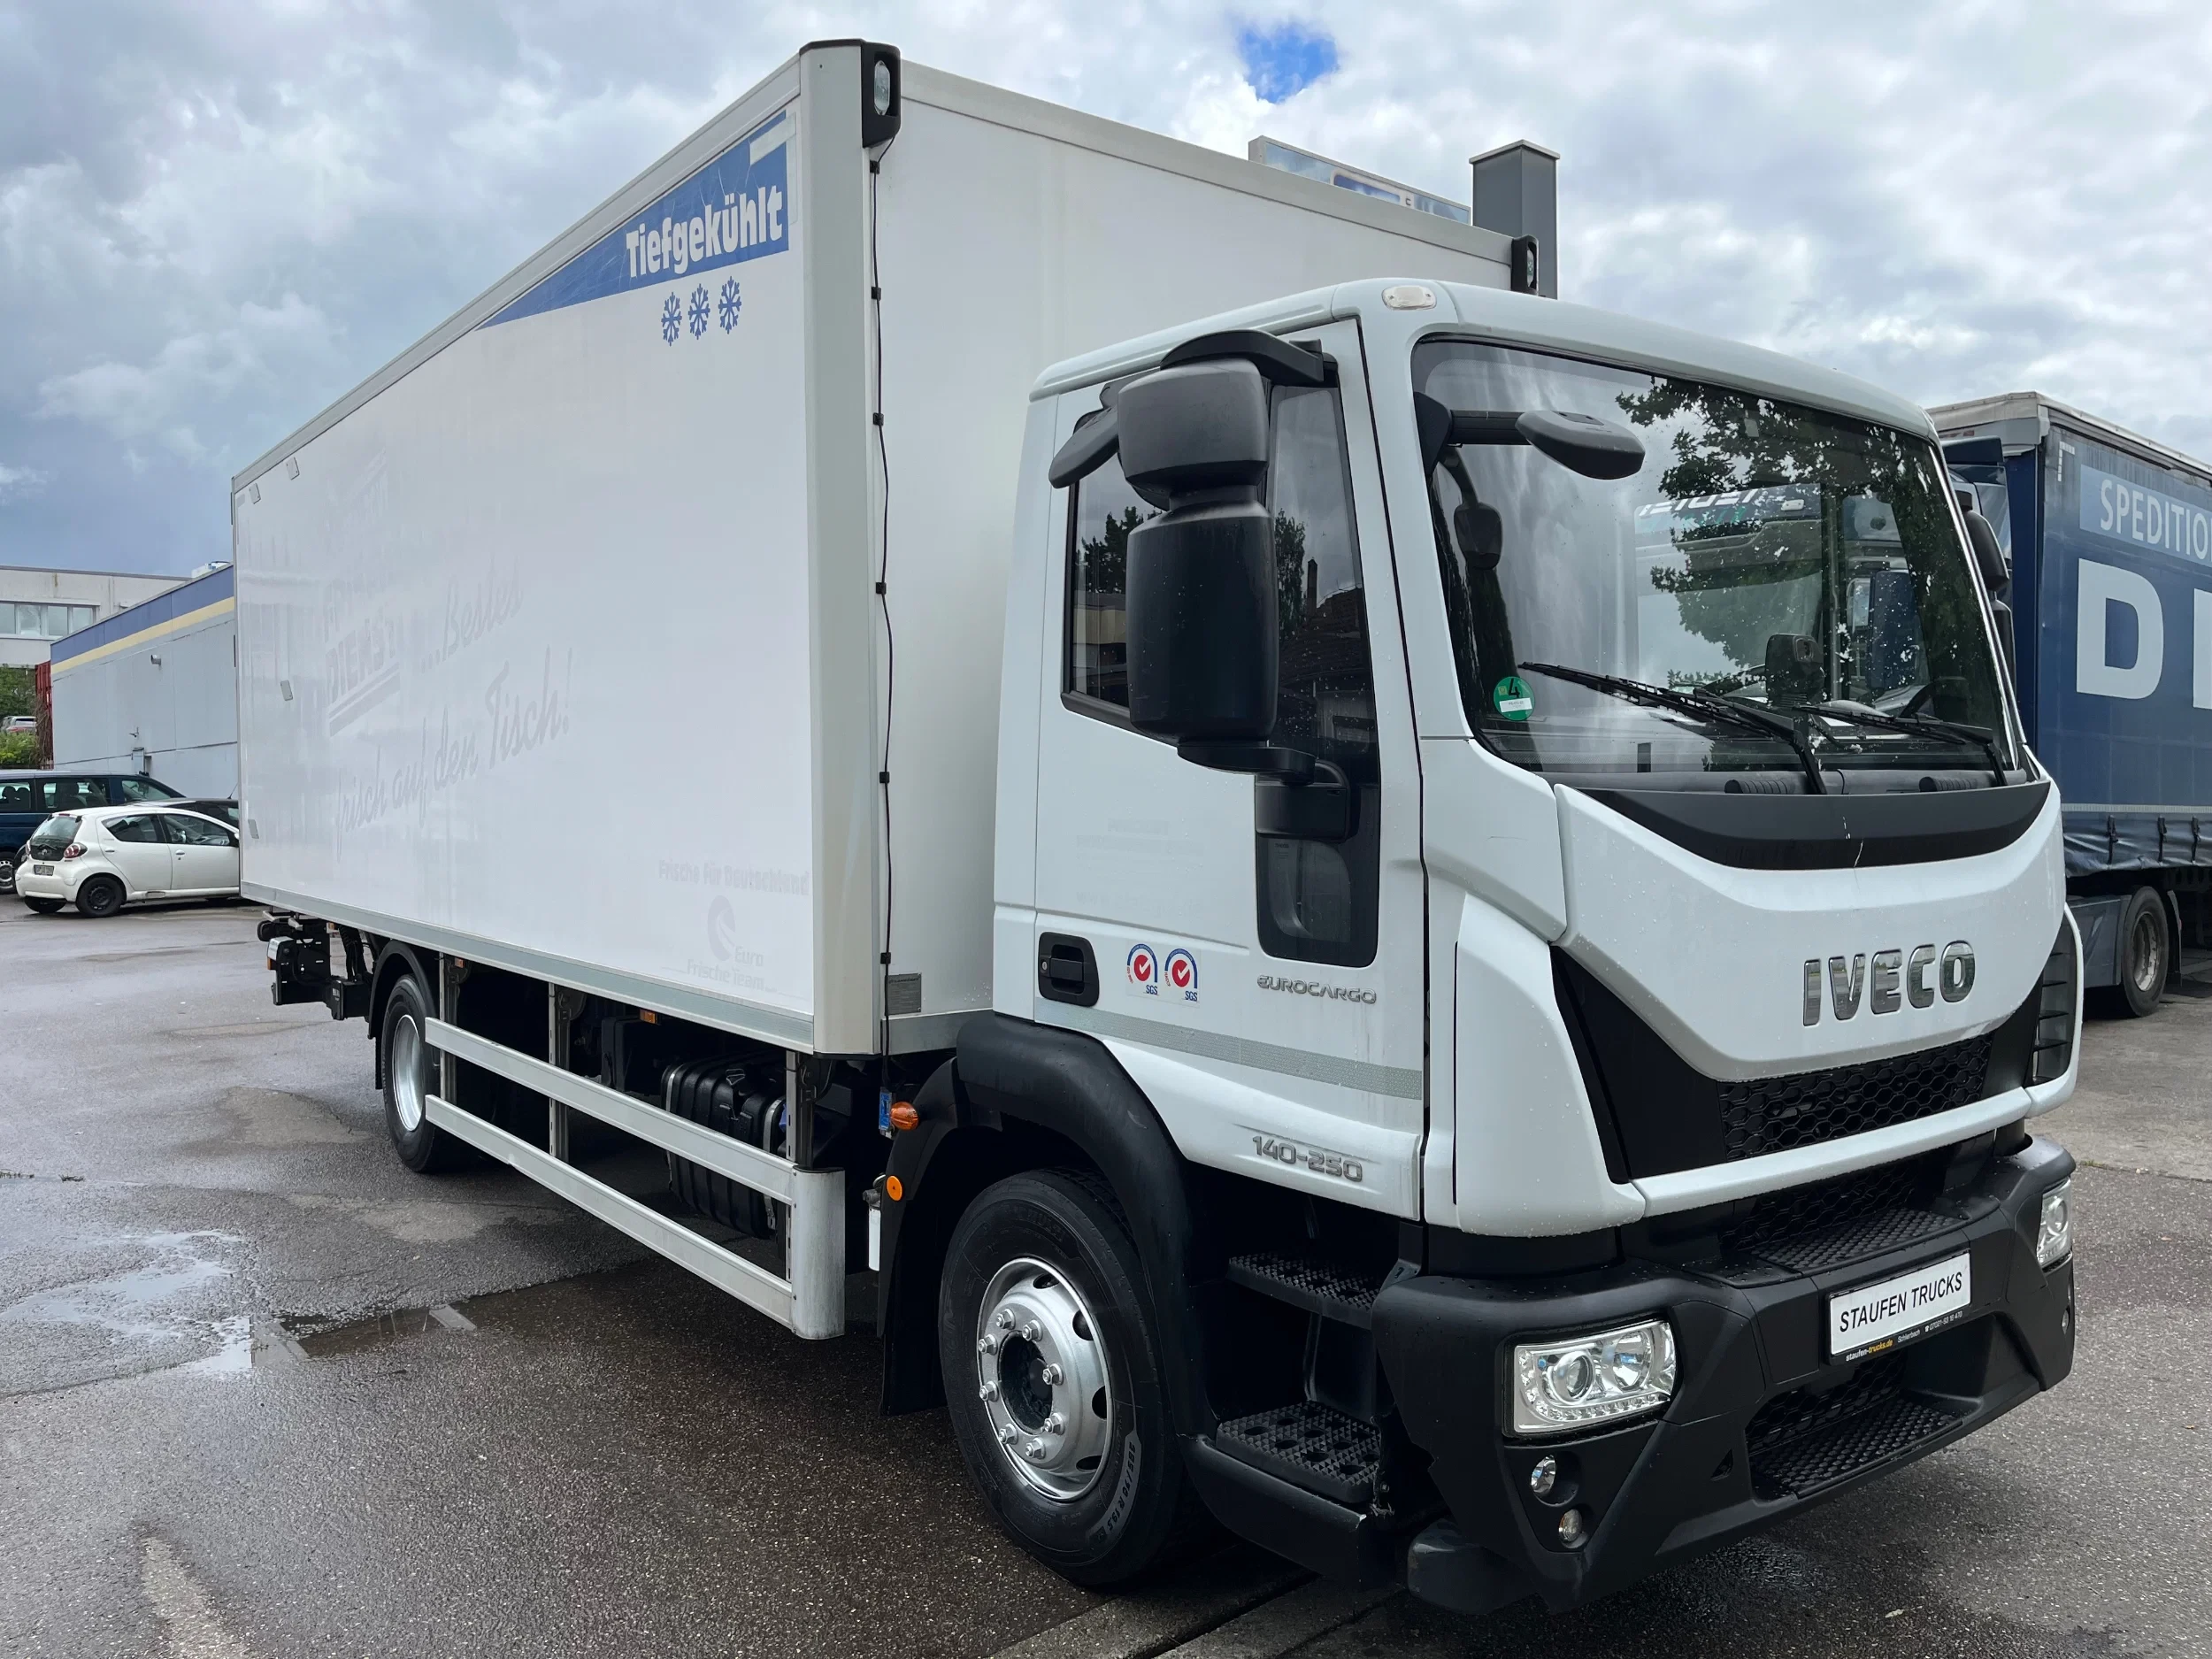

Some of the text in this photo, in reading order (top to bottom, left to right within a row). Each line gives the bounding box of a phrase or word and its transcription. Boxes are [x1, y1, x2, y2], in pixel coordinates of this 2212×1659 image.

[626, 185, 783, 278] Tiefgekühlt
[2100, 478, 2212, 562] SPEDITIO
[1509, 678, 1520, 698] 4
[434, 704, 479, 790] den
[485, 644, 573, 770] Tisch!
[733, 946, 764, 967] Euro
[687, 958, 765, 991] Frische Team
[1146, 984, 1157, 995] SGS
[1256, 974, 1377, 1005] EUROCARGO
[1802, 940, 1976, 1026] IVECO
[1185, 990, 1197, 1002] SGS
[1252, 1134, 1363, 1183] 140-250
[1839, 1271, 1962, 1332] STAUFEN TRUCKS
[1846, 1338, 1893, 1362] staufen-trucks.de
